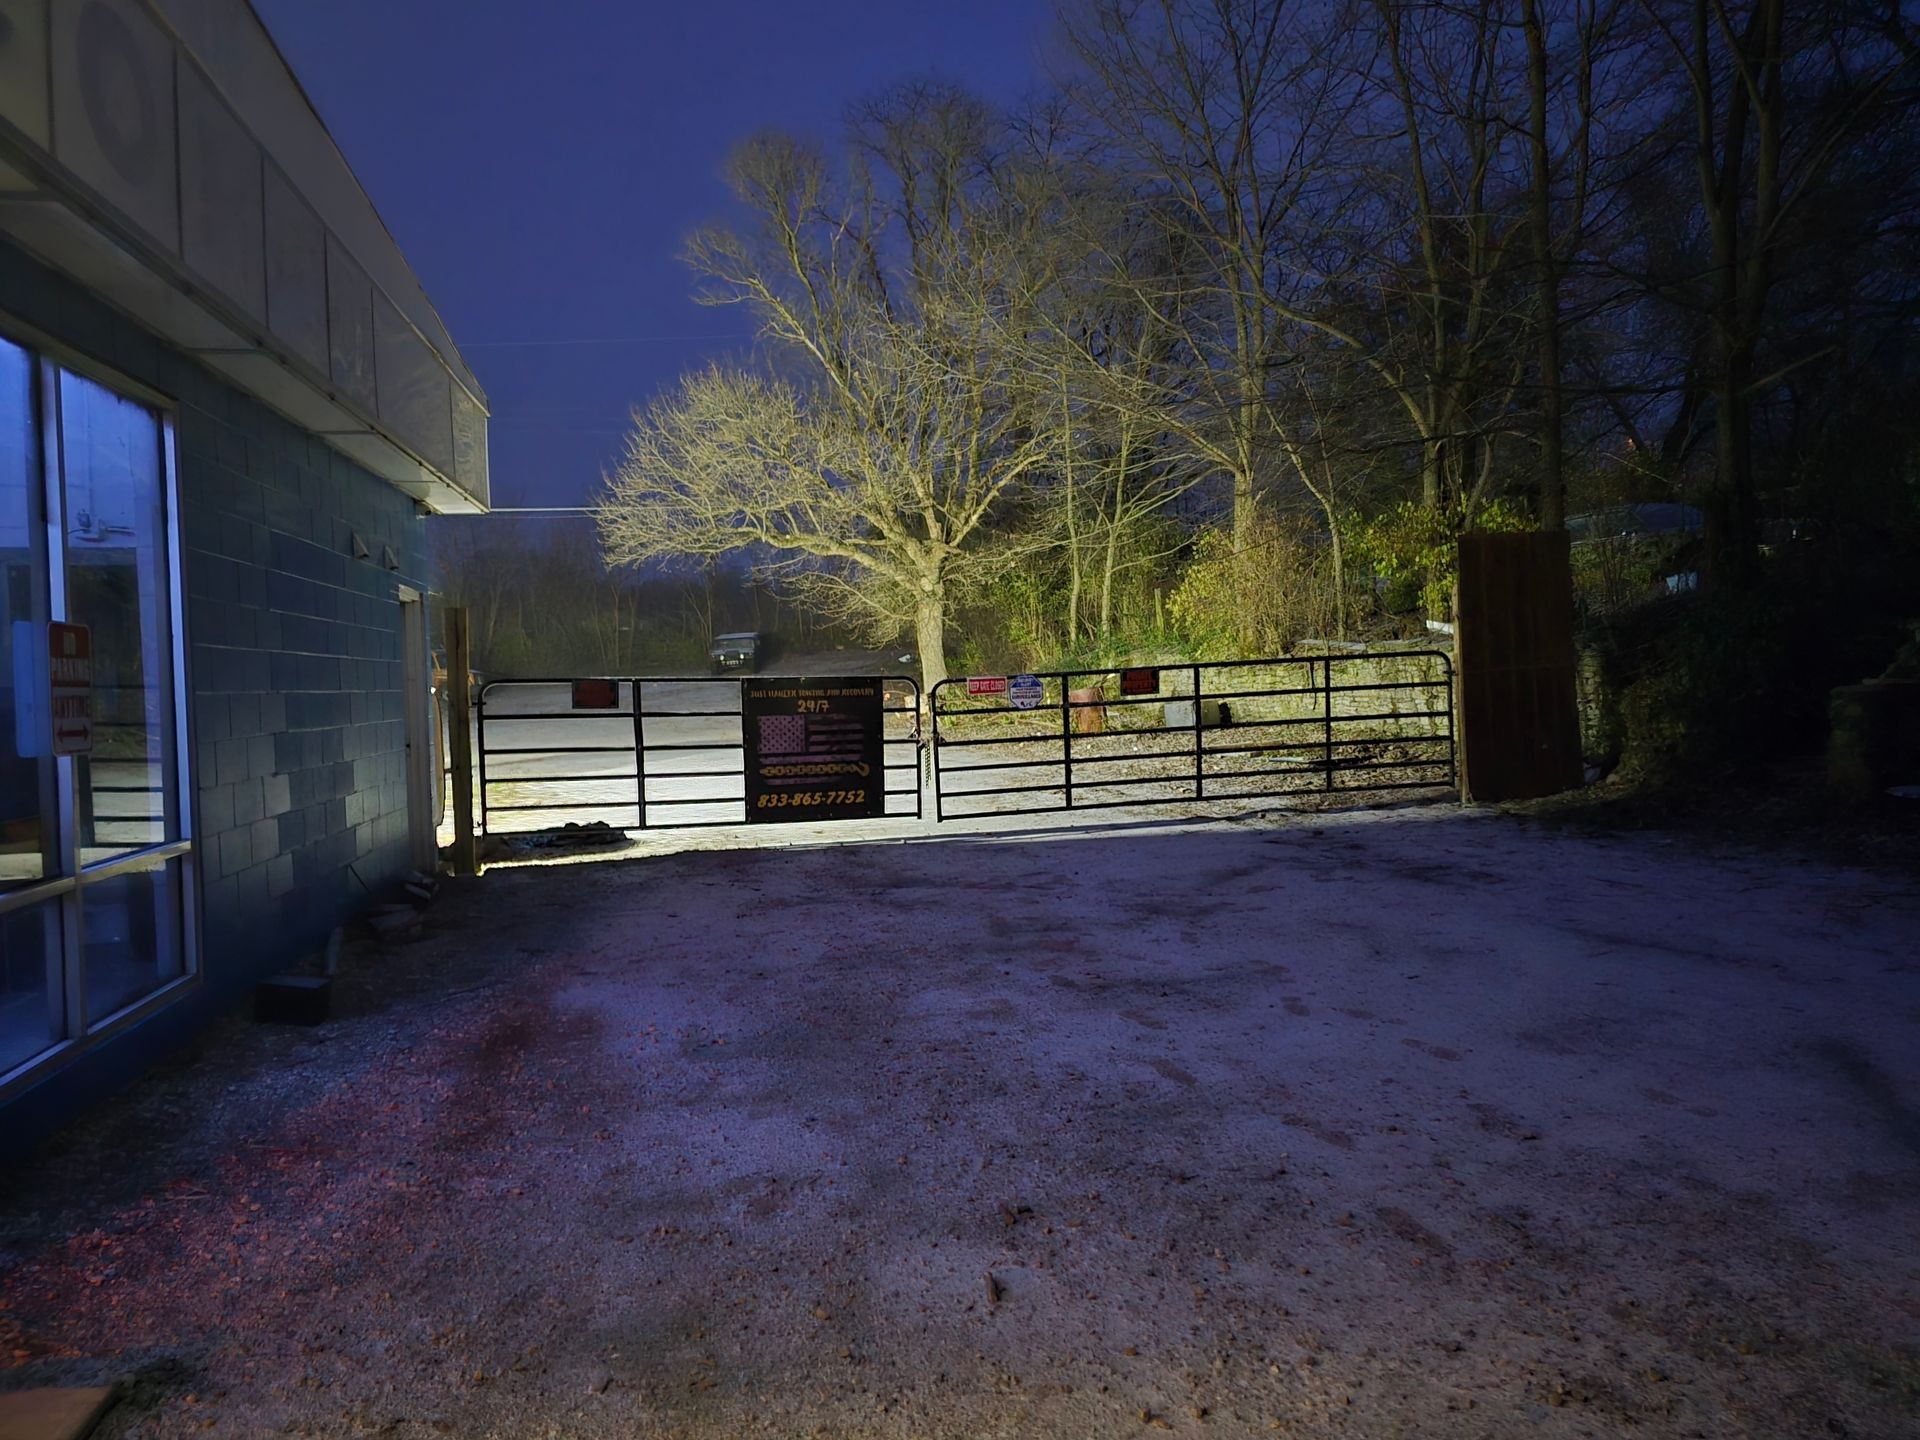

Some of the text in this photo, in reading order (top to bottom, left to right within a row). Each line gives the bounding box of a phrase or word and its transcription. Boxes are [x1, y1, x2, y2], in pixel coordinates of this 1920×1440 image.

[53, 657, 91, 682] PARKING
[799, 688, 825, 698] TOWING
[841, 687, 874, 698] RECOVERY
[797, 699, 829, 713] 24/7
[757, 790, 865, 808] 833-865-7752
